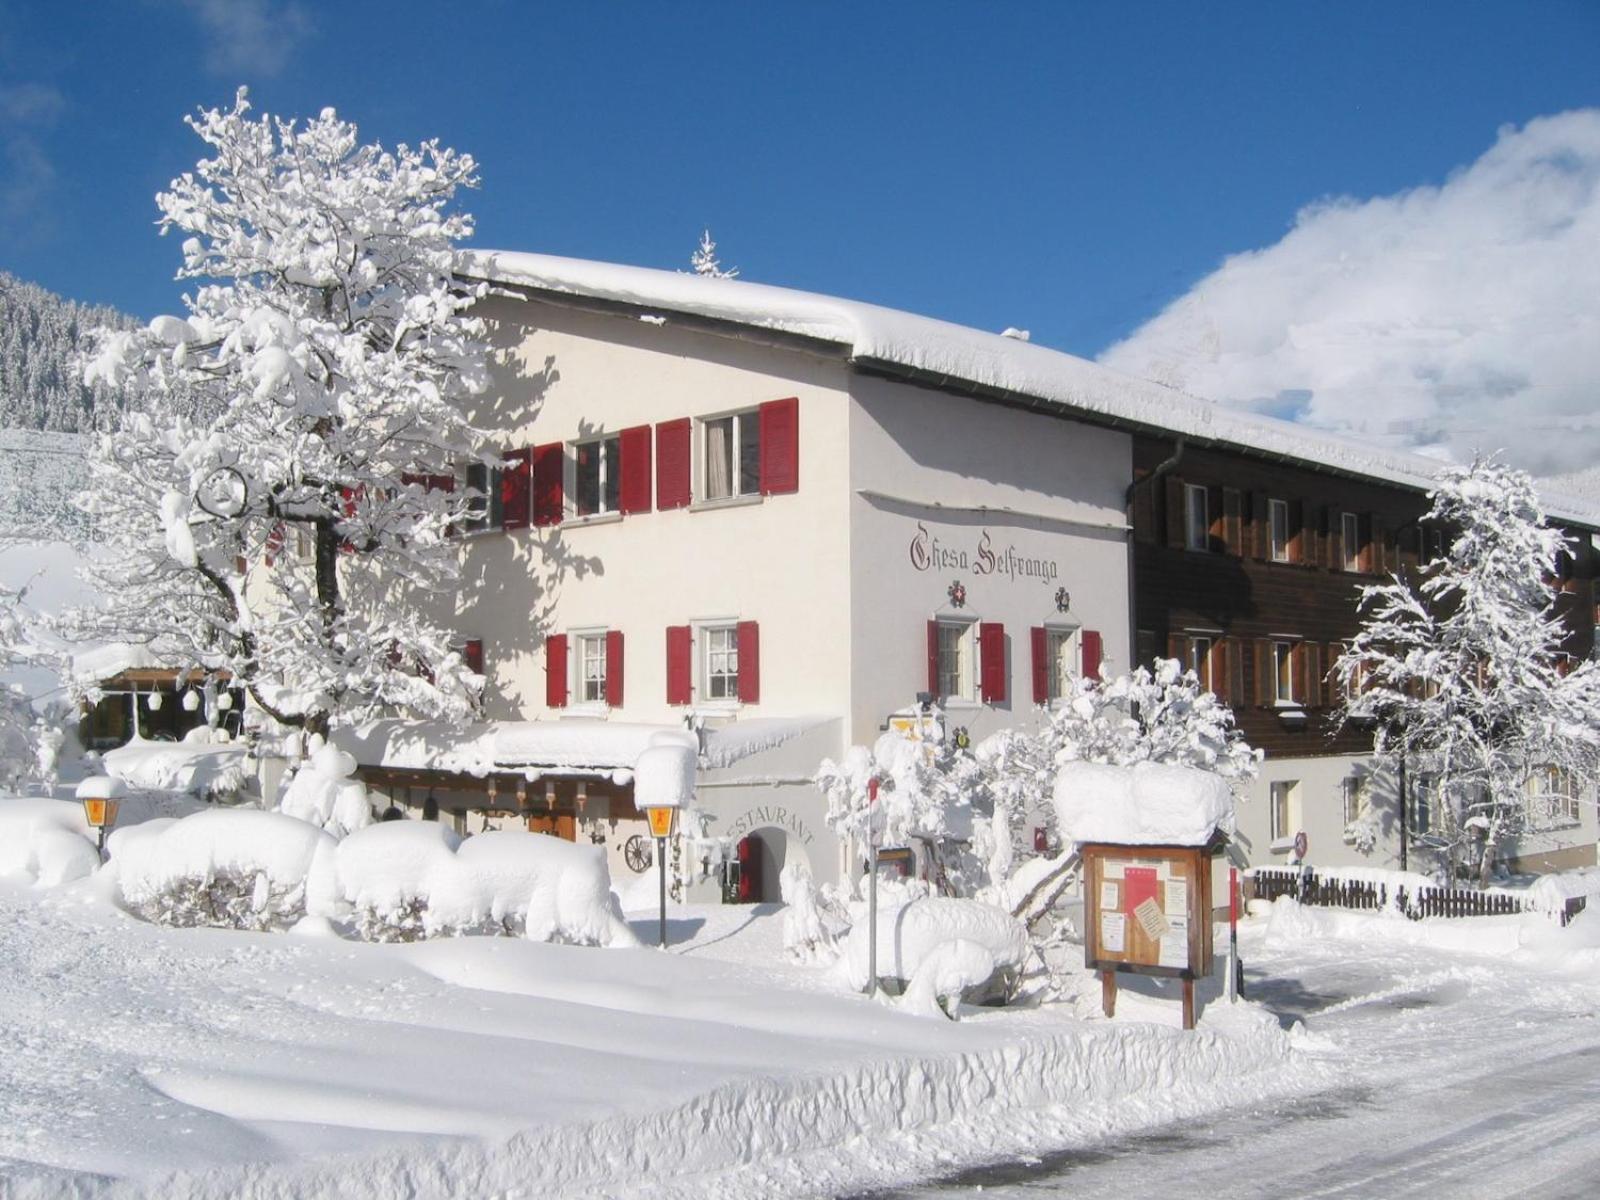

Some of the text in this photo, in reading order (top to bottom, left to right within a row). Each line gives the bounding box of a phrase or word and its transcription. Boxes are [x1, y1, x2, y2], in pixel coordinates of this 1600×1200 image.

[910, 521, 1058, 585] Chesa Selfranga
[725, 806, 815, 845] ESTAURANT
